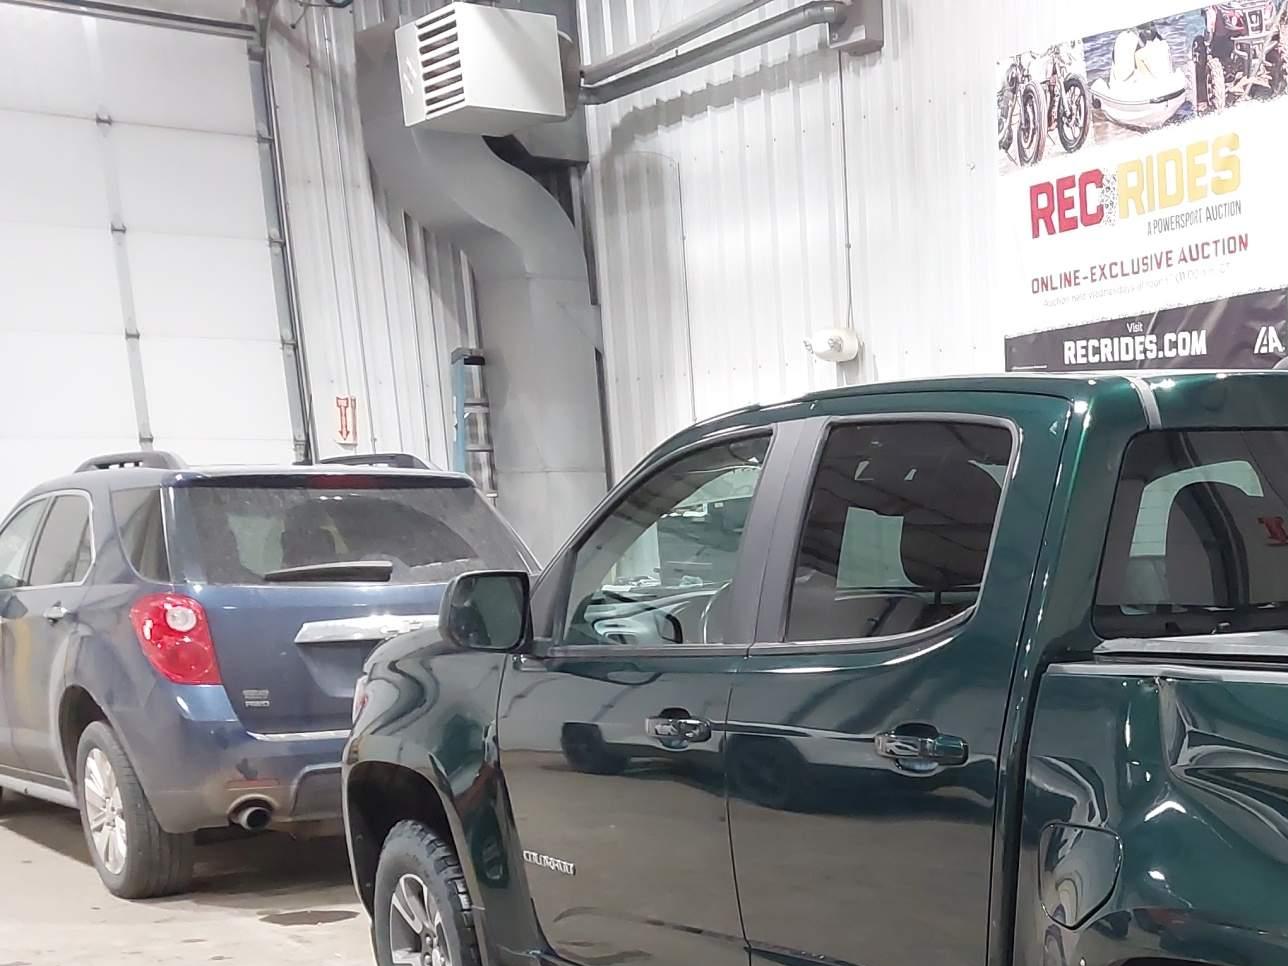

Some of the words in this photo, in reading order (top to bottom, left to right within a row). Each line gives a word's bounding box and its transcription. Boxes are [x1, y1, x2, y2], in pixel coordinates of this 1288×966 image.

[1029, 168, 1105, 240] REC
[1118, 132, 1242, 220] RIDES
[1153, 208, 1202, 235] POWERSPORT
[1206, 199, 1242, 222] AUCTION
[1031, 250, 1174, 294] ONLINE-EXCLUSIVE
[1178, 233, 1249, 264] AUCTION
[1126, 321, 1144, 333] Visit
[1063, 330, 1207, 365] RECRIDES.COM
